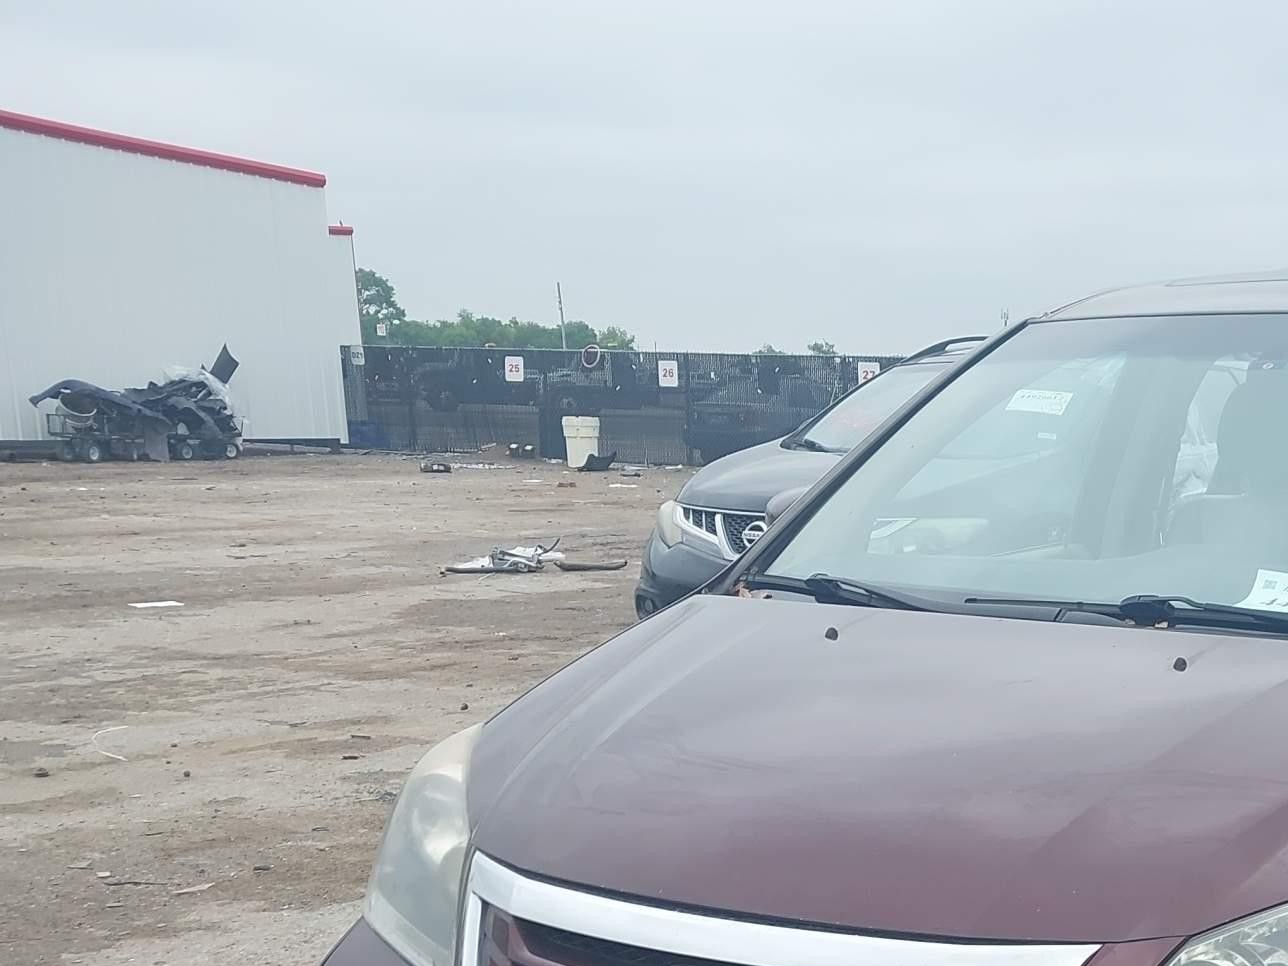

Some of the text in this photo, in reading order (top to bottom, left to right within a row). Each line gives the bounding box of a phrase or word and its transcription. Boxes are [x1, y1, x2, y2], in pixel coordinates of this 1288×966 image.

[508, 363, 520, 373] 25
[662, 369, 674, 378] 26
[863, 370, 876, 380] 27
